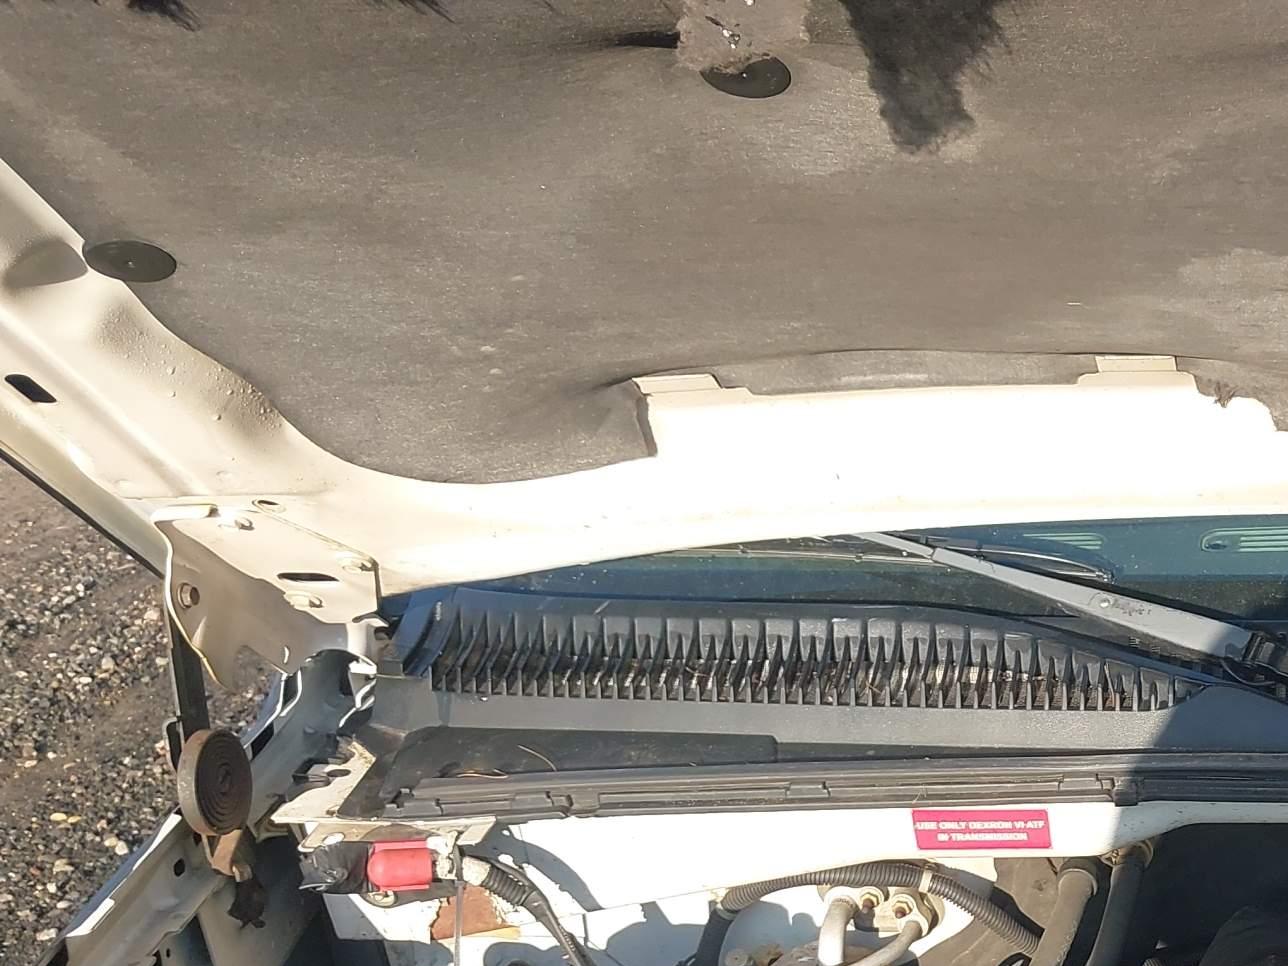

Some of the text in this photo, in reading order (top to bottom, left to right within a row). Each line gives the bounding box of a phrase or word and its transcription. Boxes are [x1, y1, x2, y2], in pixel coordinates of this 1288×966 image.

[915, 821, 938, 830] USE
[939, 821, 967, 830] ONLY
[951, 832, 1029, 841] TRANSMISSION
